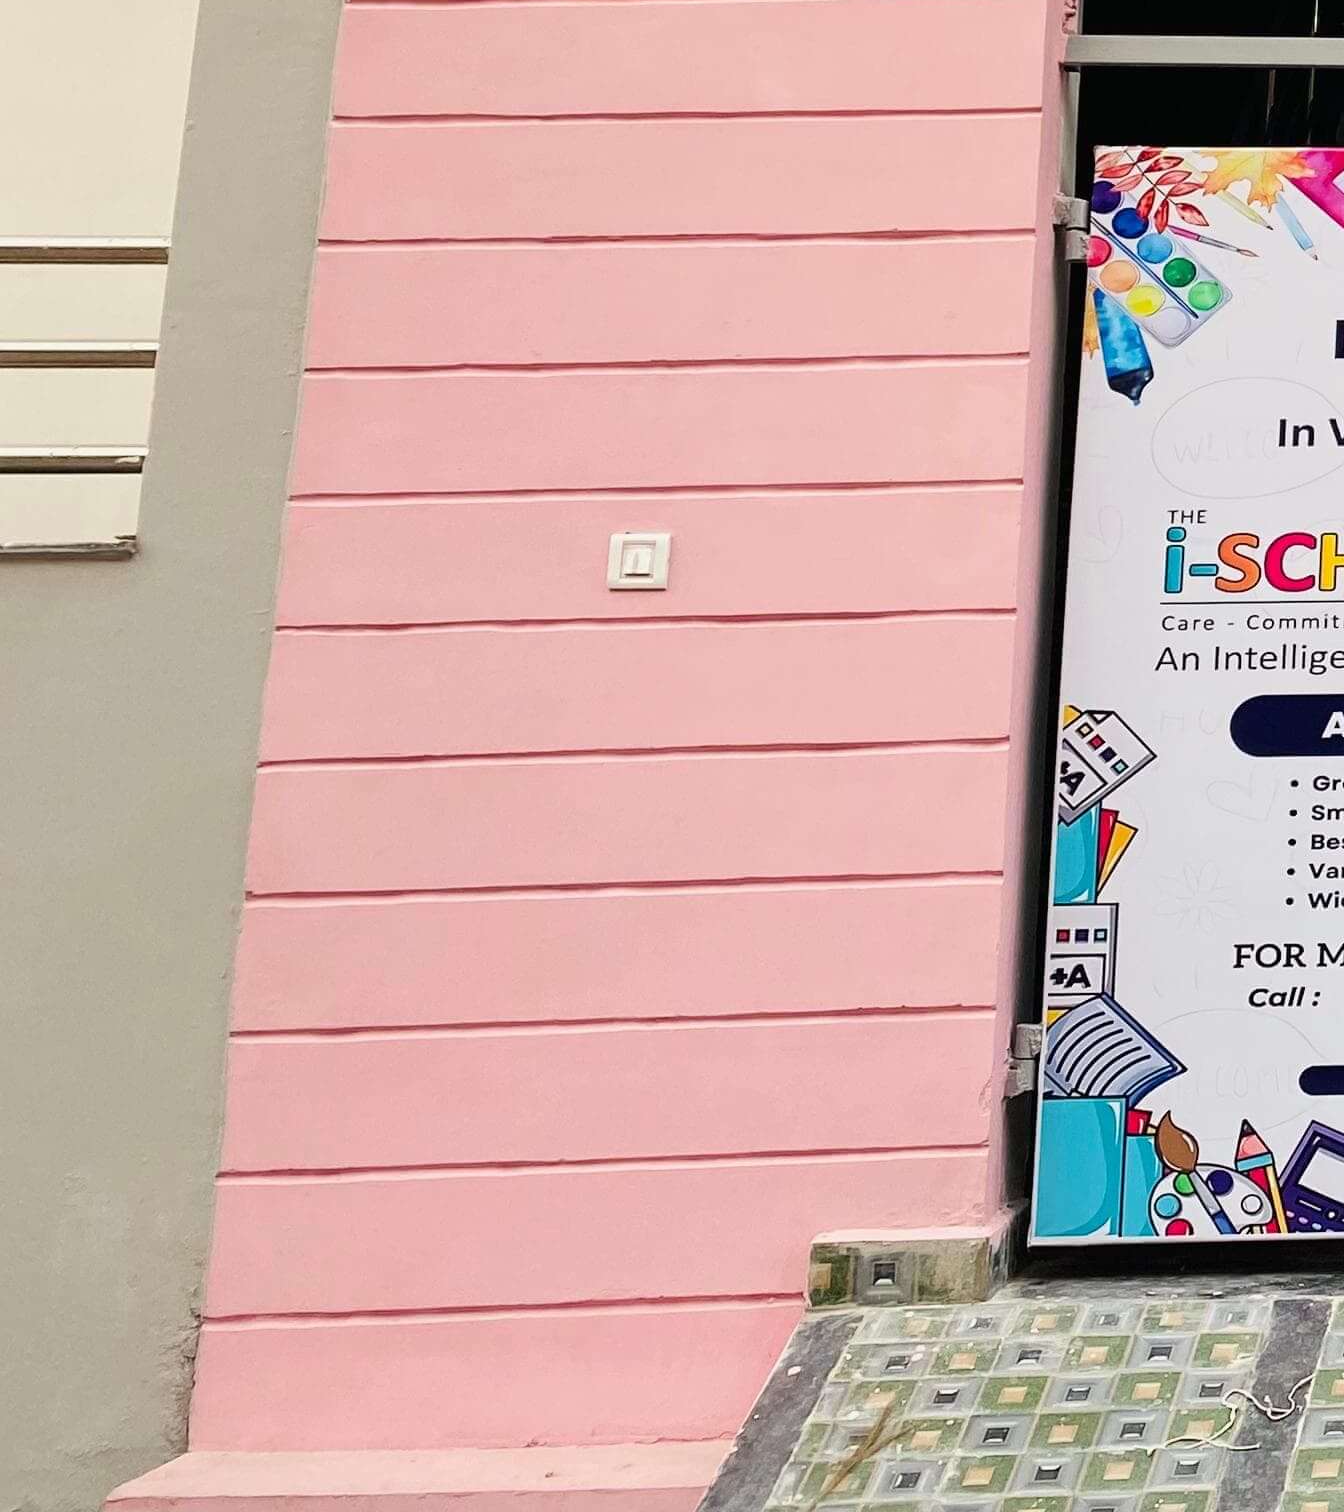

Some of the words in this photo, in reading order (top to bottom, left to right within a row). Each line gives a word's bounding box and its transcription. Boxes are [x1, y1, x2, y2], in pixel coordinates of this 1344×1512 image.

[1279, 419, 1314, 447] In
[1168, 510, 1206, 524] THE
[1162, 616, 1214, 631] Care
[1155, 647, 1199, 671] An
[1233, 944, 1306, 968] FOR
[1249, 987, 1305, 1007] Call
